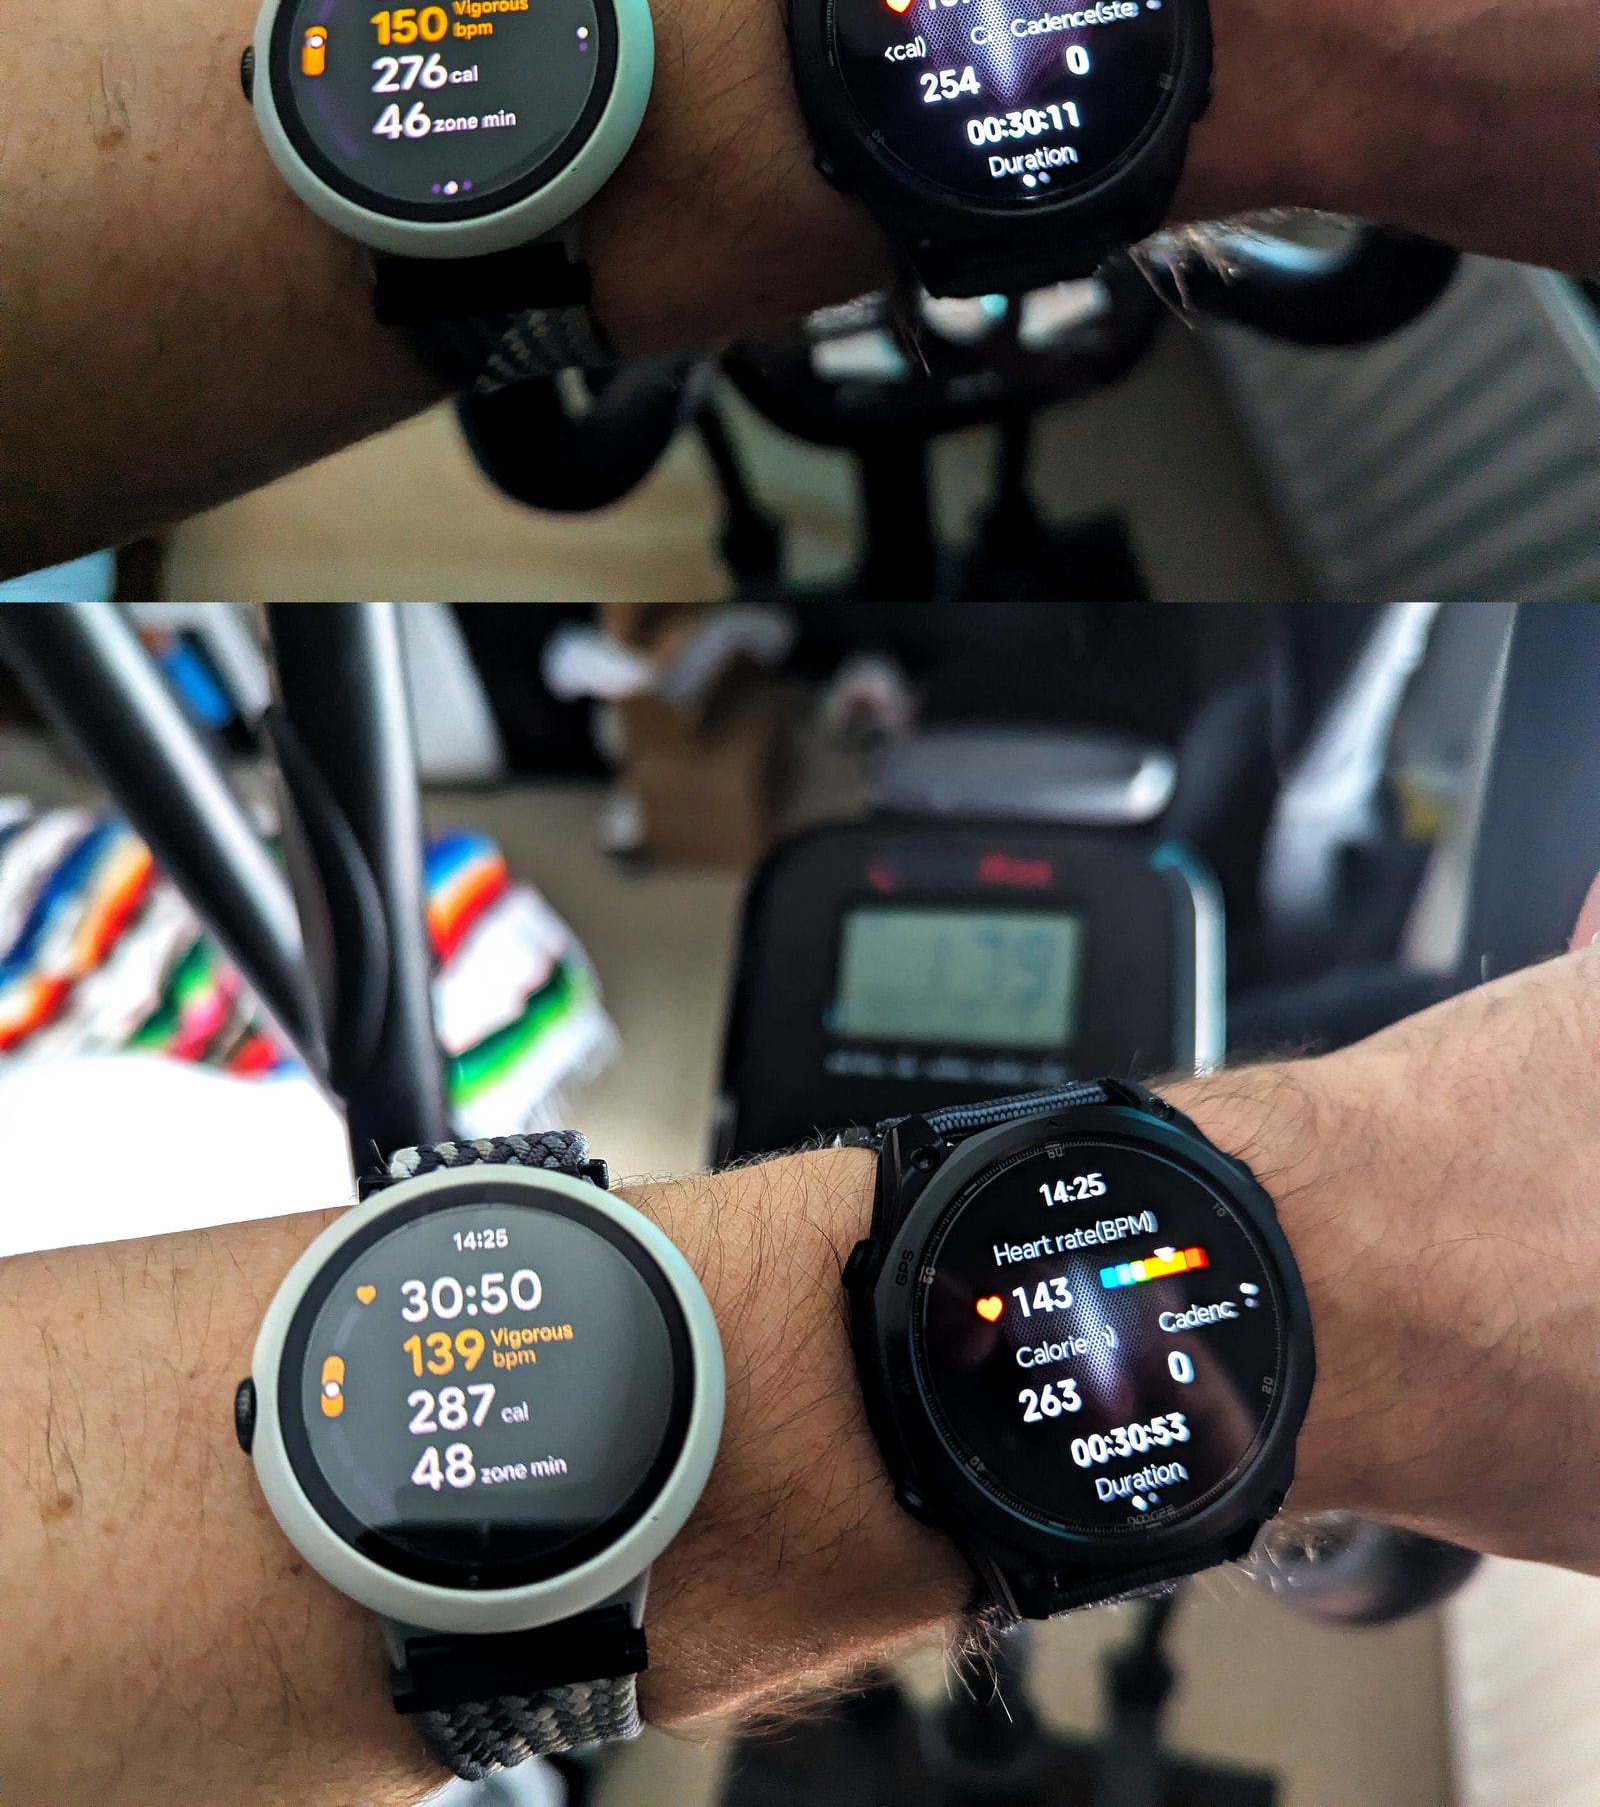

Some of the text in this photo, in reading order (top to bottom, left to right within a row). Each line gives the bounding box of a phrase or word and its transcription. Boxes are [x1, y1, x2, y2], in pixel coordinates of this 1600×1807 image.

[371, 5, 448, 46] 150
[454, 21, 493, 39] bpm
[372, 53, 479, 93] 276 cal
[1065, 44, 1090, 75] 0
[919, 65, 981, 103] 254
[373, 102, 517, 139] 46 zone min
[966, 101, 1081, 146] 00:30:11
[989, 143, 1078, 178] Duration
[1039, 1172, 1107, 1207] 14:25
[453, 1228, 509, 1252] 14:25
[993, 1210, 1158, 1266] Heart rate(BPM)
[401, 1269, 542, 1323] 30:50
[1012, 1276, 1074, 1318] 143
[404, 1323, 574, 1377] 139 Vigorous
[493, 1349, 537, 1371] bpm
[1167, 1350, 1195, 1384] 0
[407, 1383, 529, 1435] 287 cal
[1018, 1377, 1082, 1423] 263
[1070, 1411, 1190, 1468] 00:30:53
[411, 1442, 568, 1491] 48 zone min
[1095, 1462, 1189, 1503] Duration
